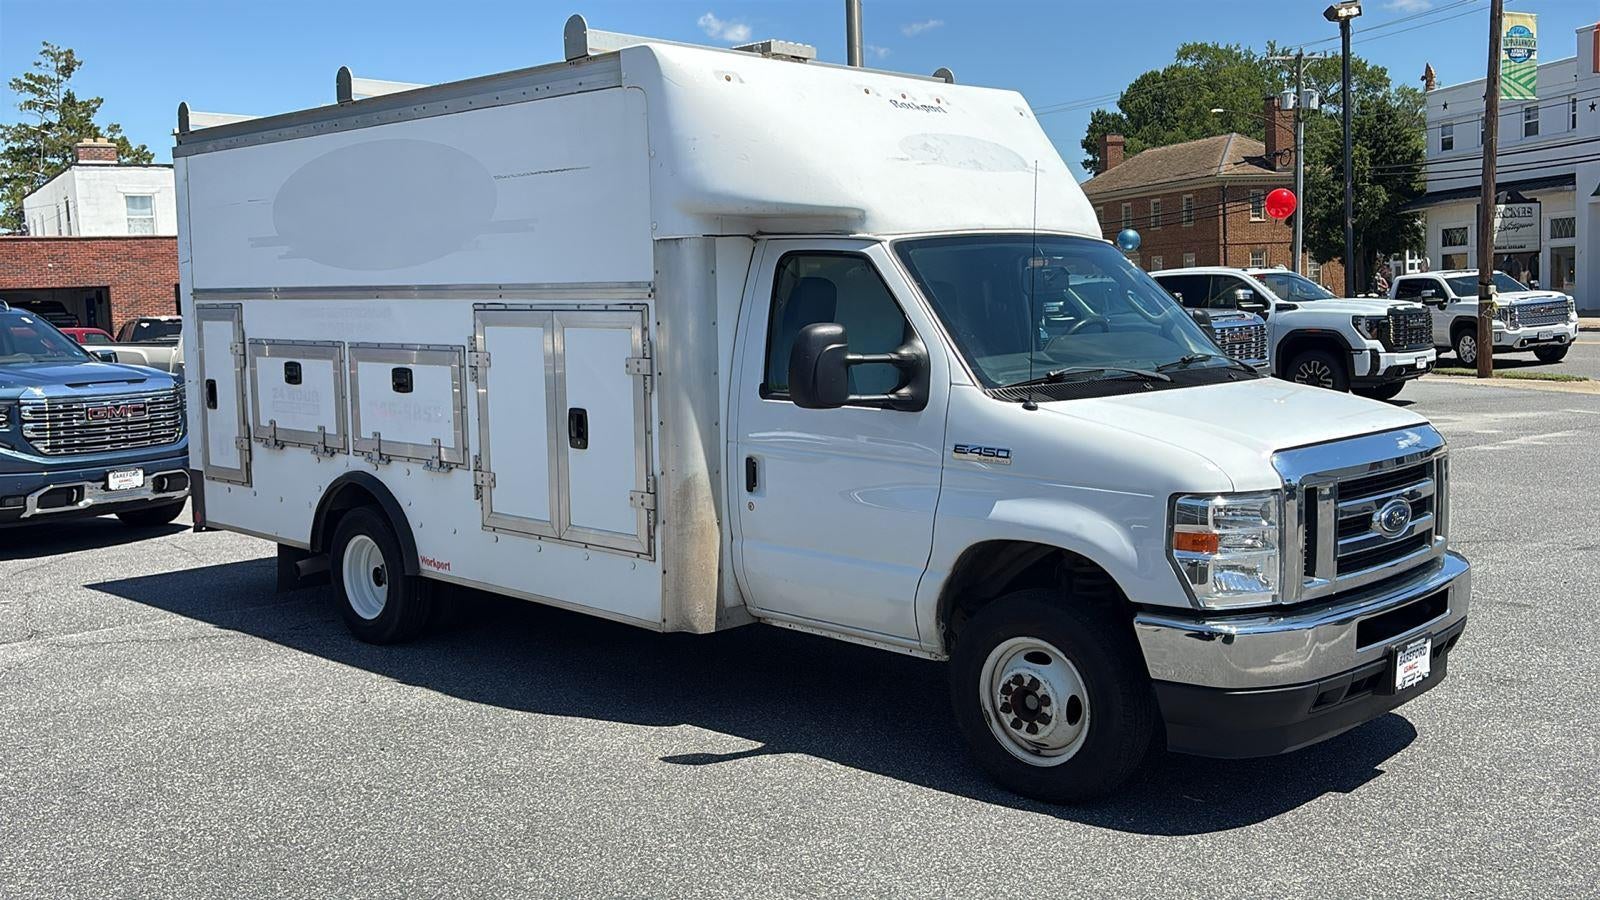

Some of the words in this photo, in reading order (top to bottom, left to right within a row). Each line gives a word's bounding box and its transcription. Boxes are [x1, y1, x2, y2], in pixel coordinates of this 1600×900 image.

[889, 99, 948, 113] Rockport
[88, 404, 144, 419] GMC
[420, 555, 451, 571] Workport
[1399, 646, 1427, 666] BAREFORD
[1404, 661, 1418, 674] GMC
